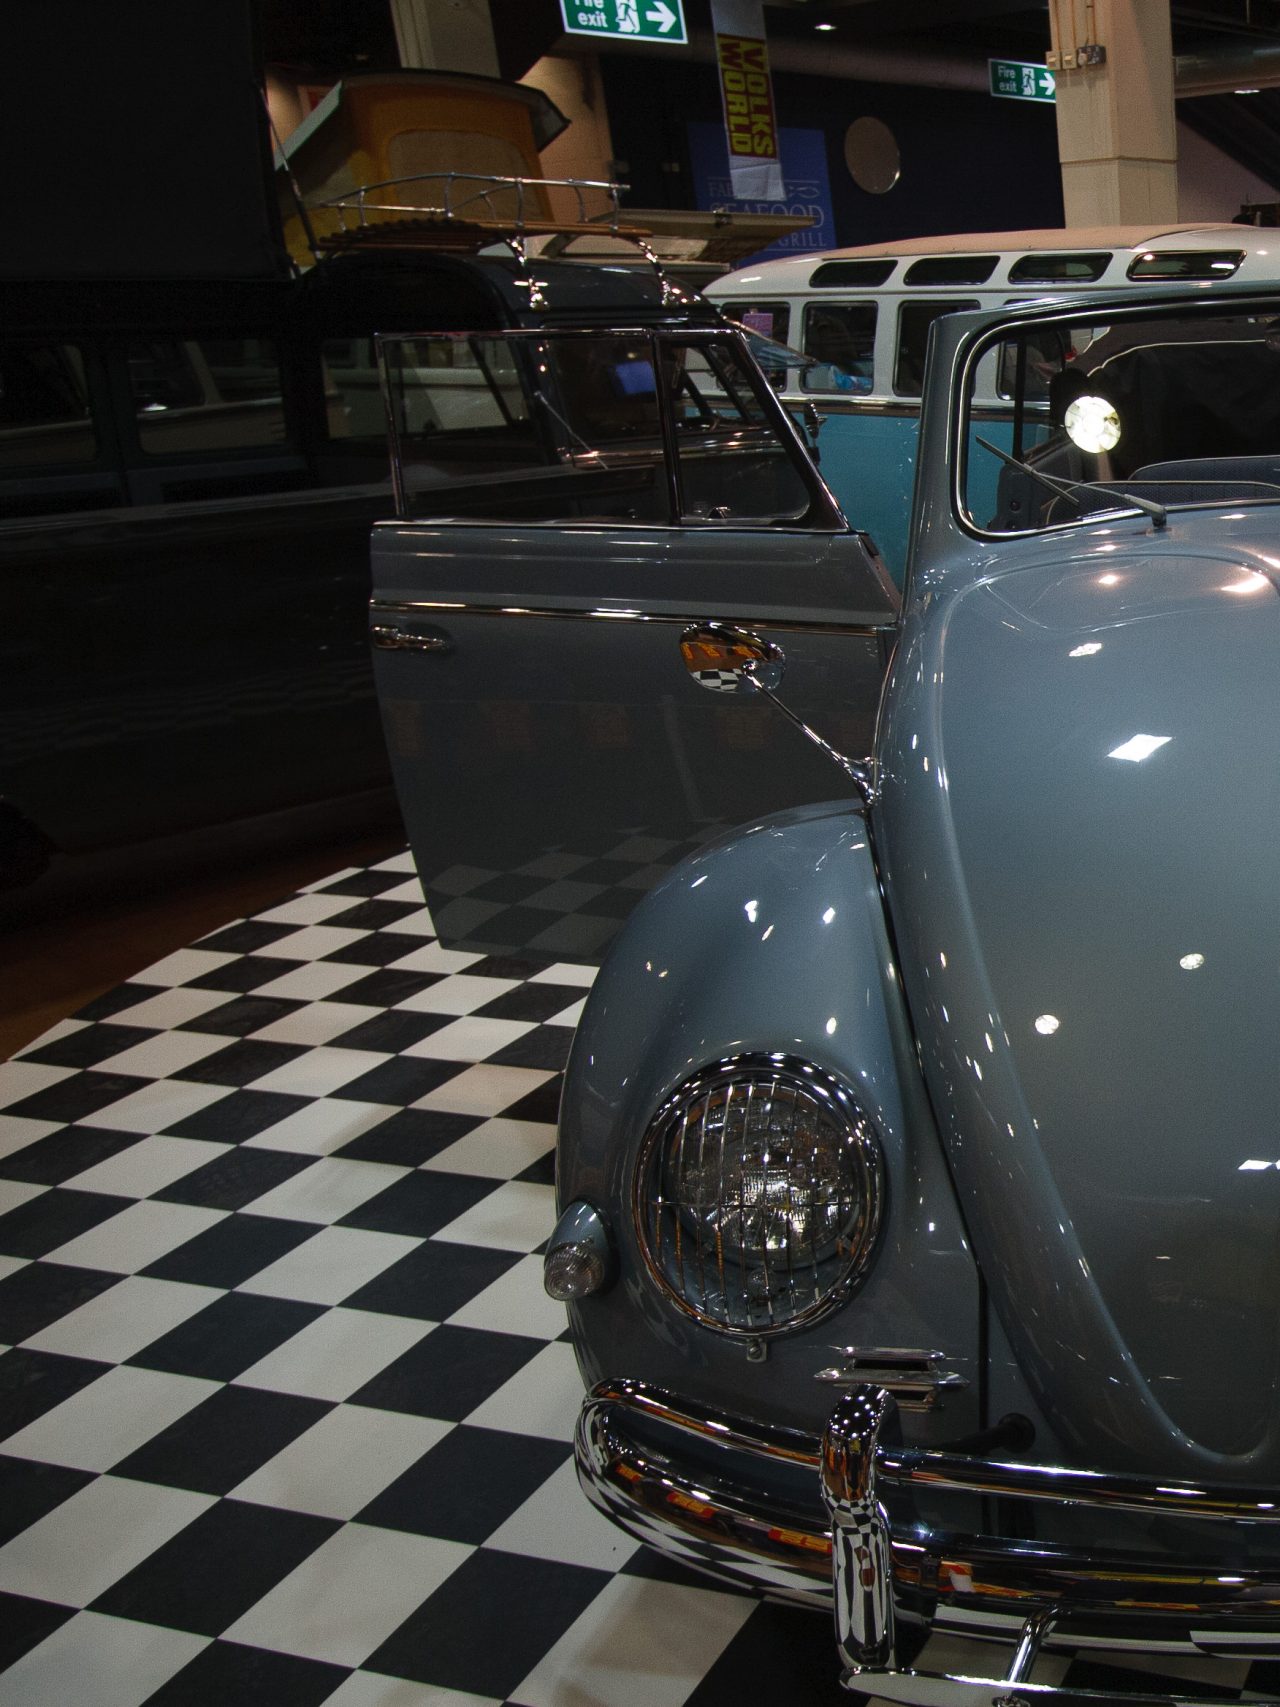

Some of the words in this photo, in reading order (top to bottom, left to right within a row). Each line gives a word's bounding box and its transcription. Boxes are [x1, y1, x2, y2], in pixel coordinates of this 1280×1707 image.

[577, 11, 608, 28] exit
[997, 65, 1016, 79] Fire
[998, 80, 1017, 93] exit
[720, 42, 753, 154] WORLD
[743, 47, 775, 156] VOLKS
